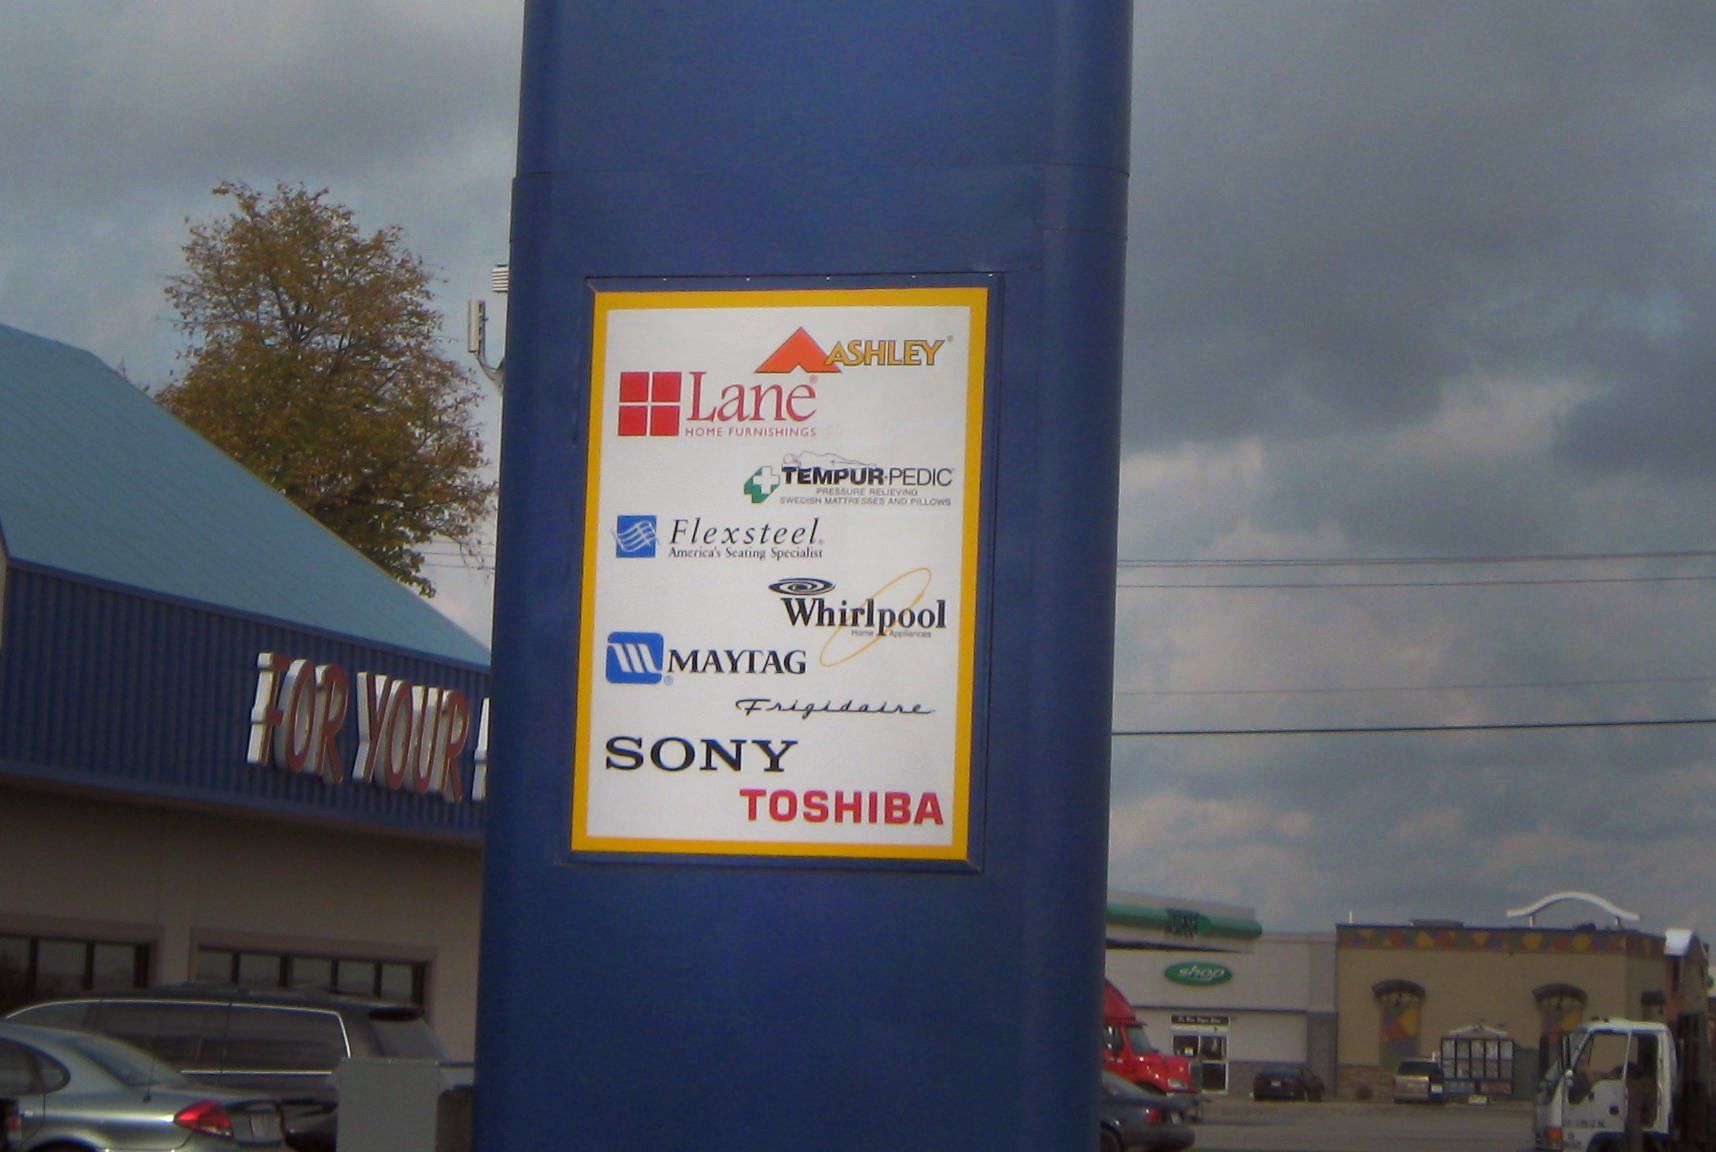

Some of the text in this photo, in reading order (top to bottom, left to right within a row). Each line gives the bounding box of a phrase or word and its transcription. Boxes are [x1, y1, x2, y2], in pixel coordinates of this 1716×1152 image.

[824, 339, 945, 367] ASHLEY
[686, 371, 817, 423] Lane
[685, 427, 817, 438] HOME FURNISHINGS
[779, 496, 951, 506] SWEDISH MATTRESSES AND PILLOWS
[815, 487, 918, 496] PRESSURE RELIEVING
[668, 517, 820, 545] Flexsteel
[668, 547, 823, 561] America's Seating Specialist
[781, 597, 947, 636] Whirlpool
[667, 649, 806, 674] MAYTAG
[735, 698, 936, 719] Frigidaire
[247, 652, 348, 784] FOR
[352, 671, 470, 804] YOUR
[605, 736, 798, 772] SONY
[740, 789, 944, 825] TOSHIBA
